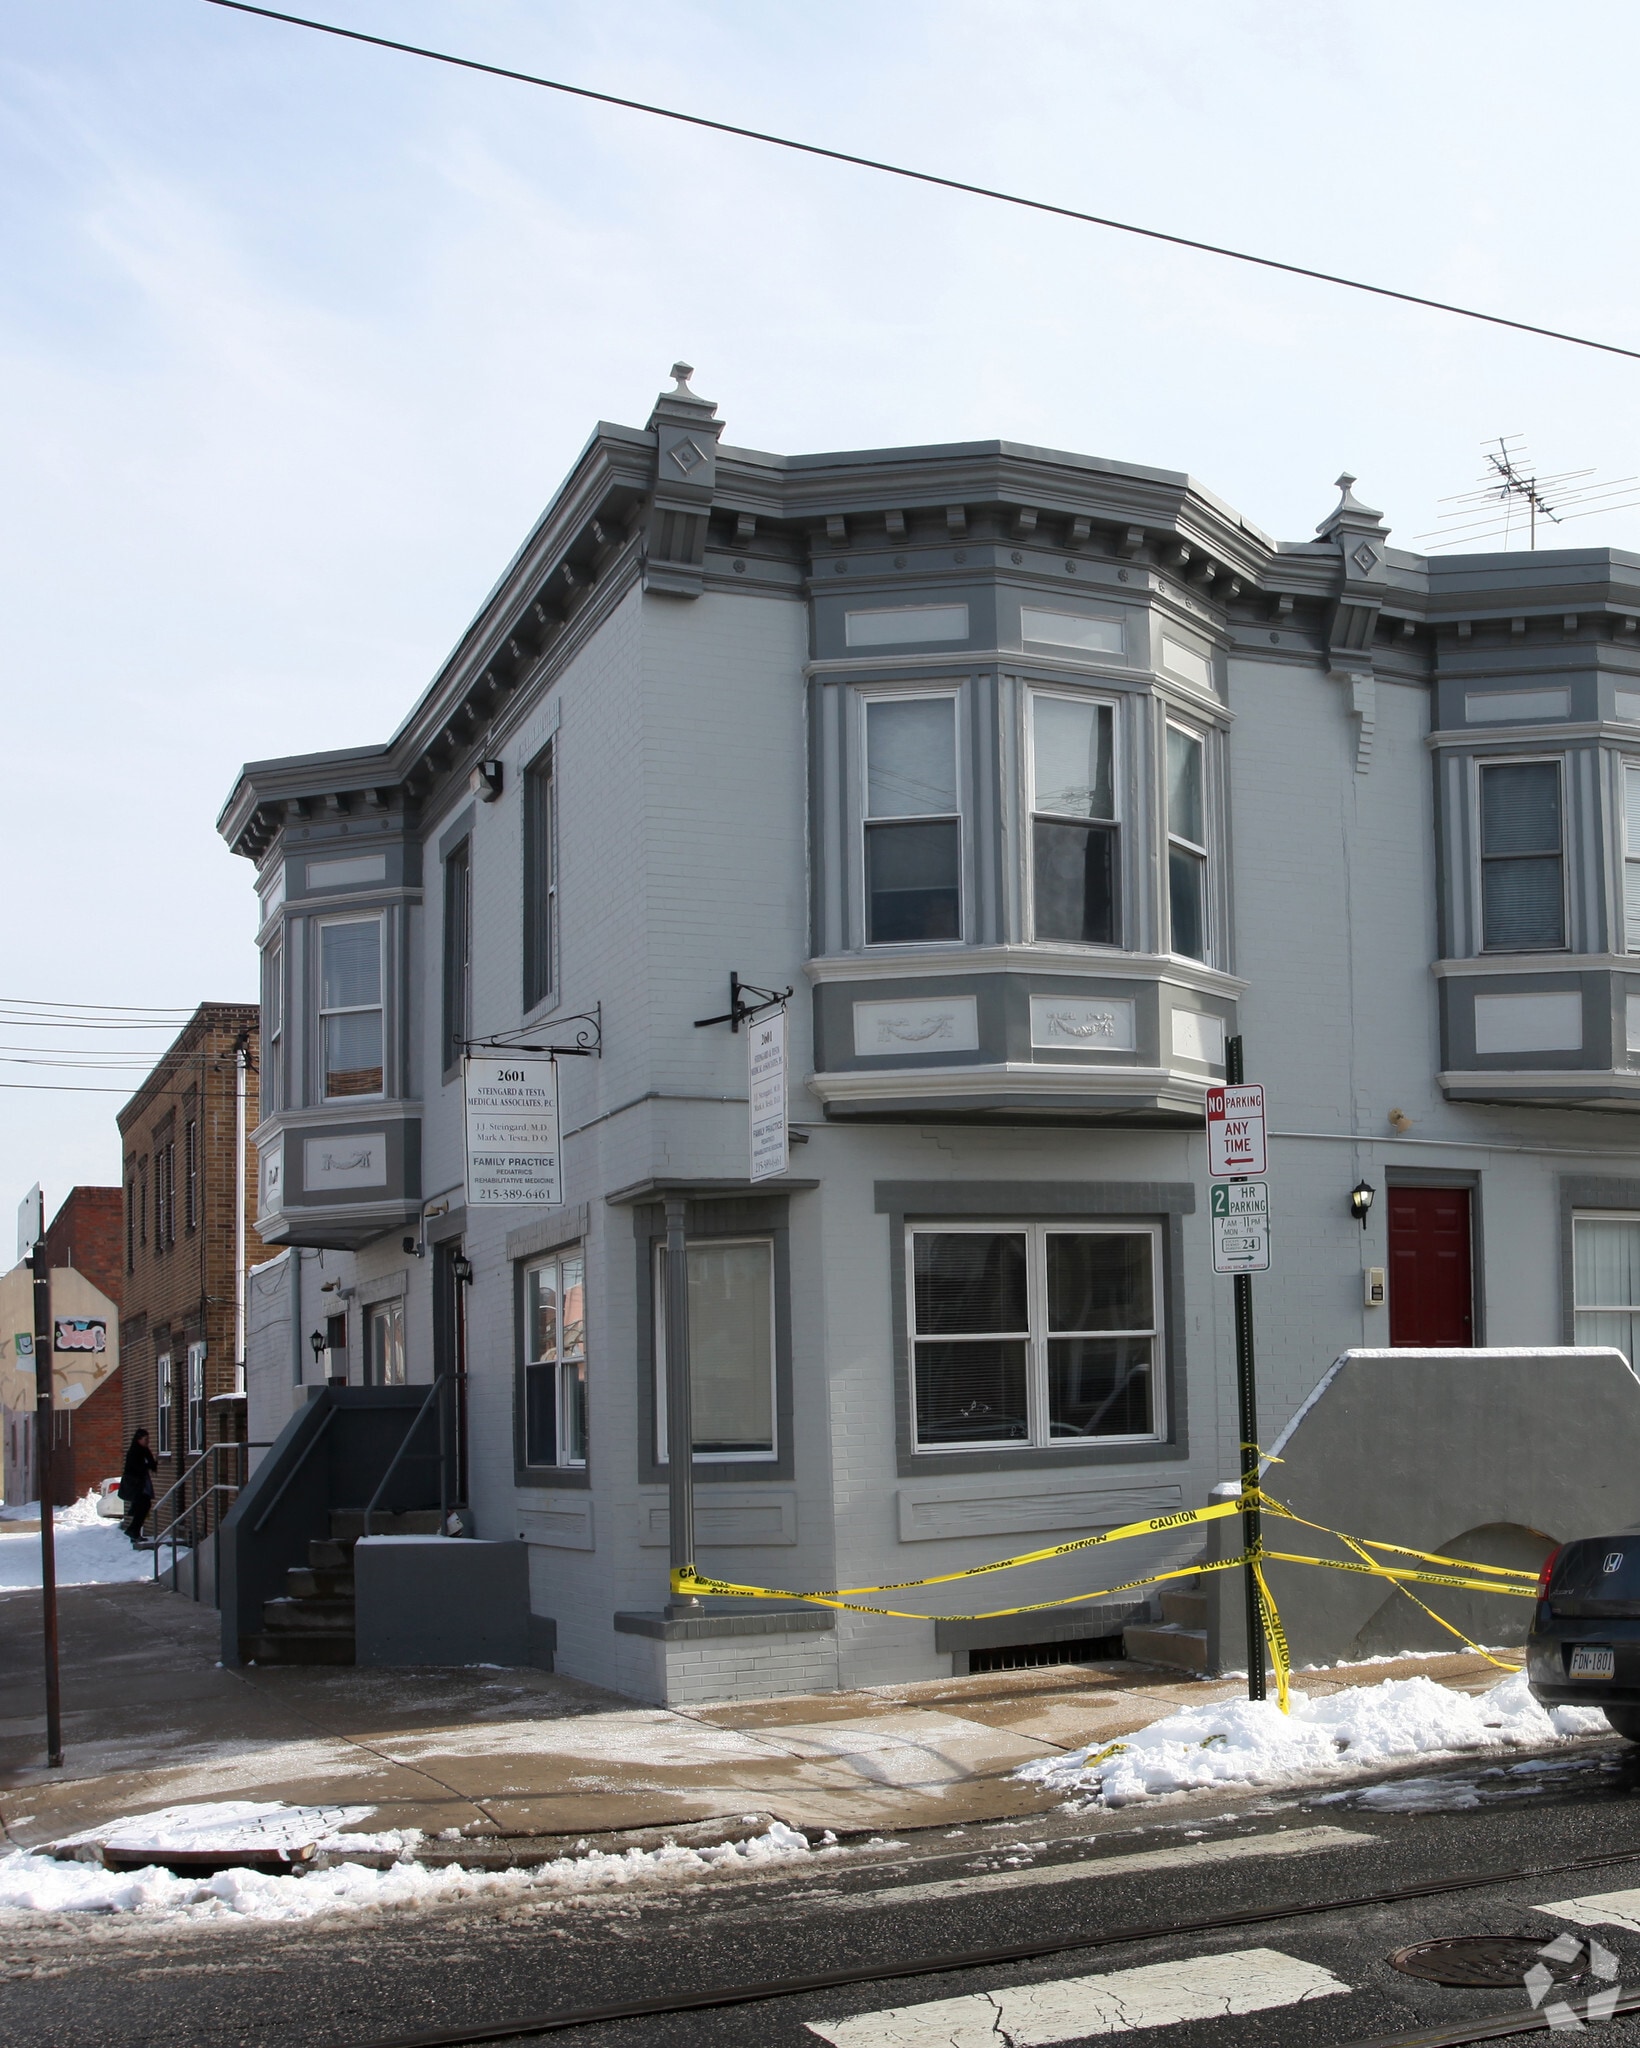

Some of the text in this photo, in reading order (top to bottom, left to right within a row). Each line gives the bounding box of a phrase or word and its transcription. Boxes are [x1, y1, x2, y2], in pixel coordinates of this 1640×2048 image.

[497, 1069, 526, 1082] 2601
[478, 1087, 546, 1097] STEINGARD & TESTA
[468, 1097, 498, 1106] MEDICAL
[1208, 1095, 1261, 1112] NO PARKING
[1225, 1121, 1249, 1136] ANY
[1224, 1138, 1251, 1153] TIME
[473, 1157, 555, 1167] FAMILY PRACTICE
[480, 1189, 551, 1199] 215-389-6461
[1215, 1187, 1256, 1212] 2 HR
[1230, 1200, 1266, 1213] PARKING
[1220, 1217, 1225, 1228] 7
[1242, 1238, 1256, 1250] 24
[1149, 1511, 1198, 1531] CAUTION
